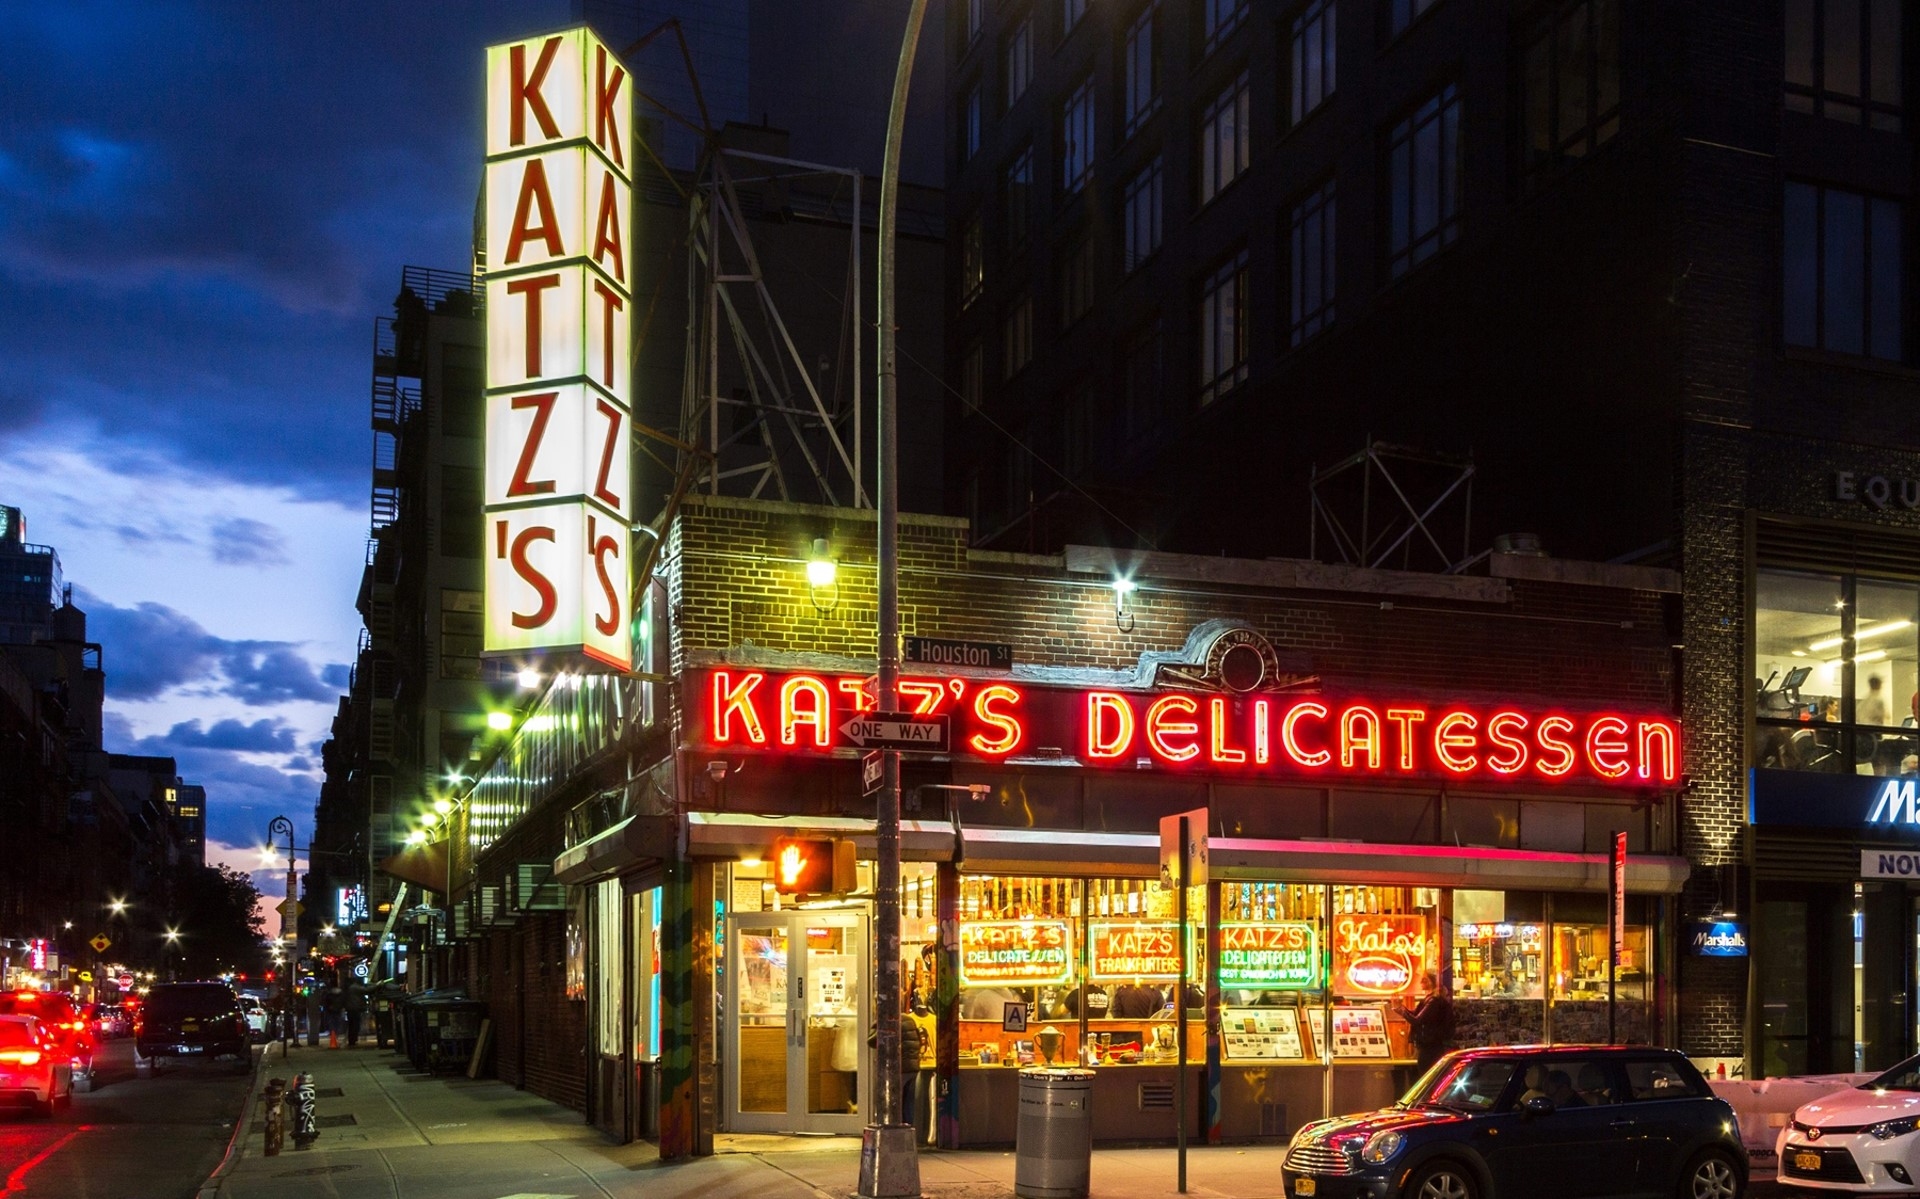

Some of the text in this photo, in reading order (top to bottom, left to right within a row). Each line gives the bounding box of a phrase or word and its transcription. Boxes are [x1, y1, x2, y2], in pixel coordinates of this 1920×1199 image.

[497, 36, 564, 630] KATZ'S
[588, 44, 625, 637] KATZ'S
[906, 639, 1008, 666] E Houston St
[850, 722, 934, 740] ONE WAY
[1087, 692, 1674, 781] DELICATESSEN
[1878, 854, 1920, 875] NO
[1108, 931, 1174, 955] KATZ'S
[1225, 926, 1304, 949] KATZ'S
[1693, 931, 1746, 947] Marshalls
[1098, 957, 1181, 973] FRANKFURTERS
[1008, 1006, 1022, 1023] A
